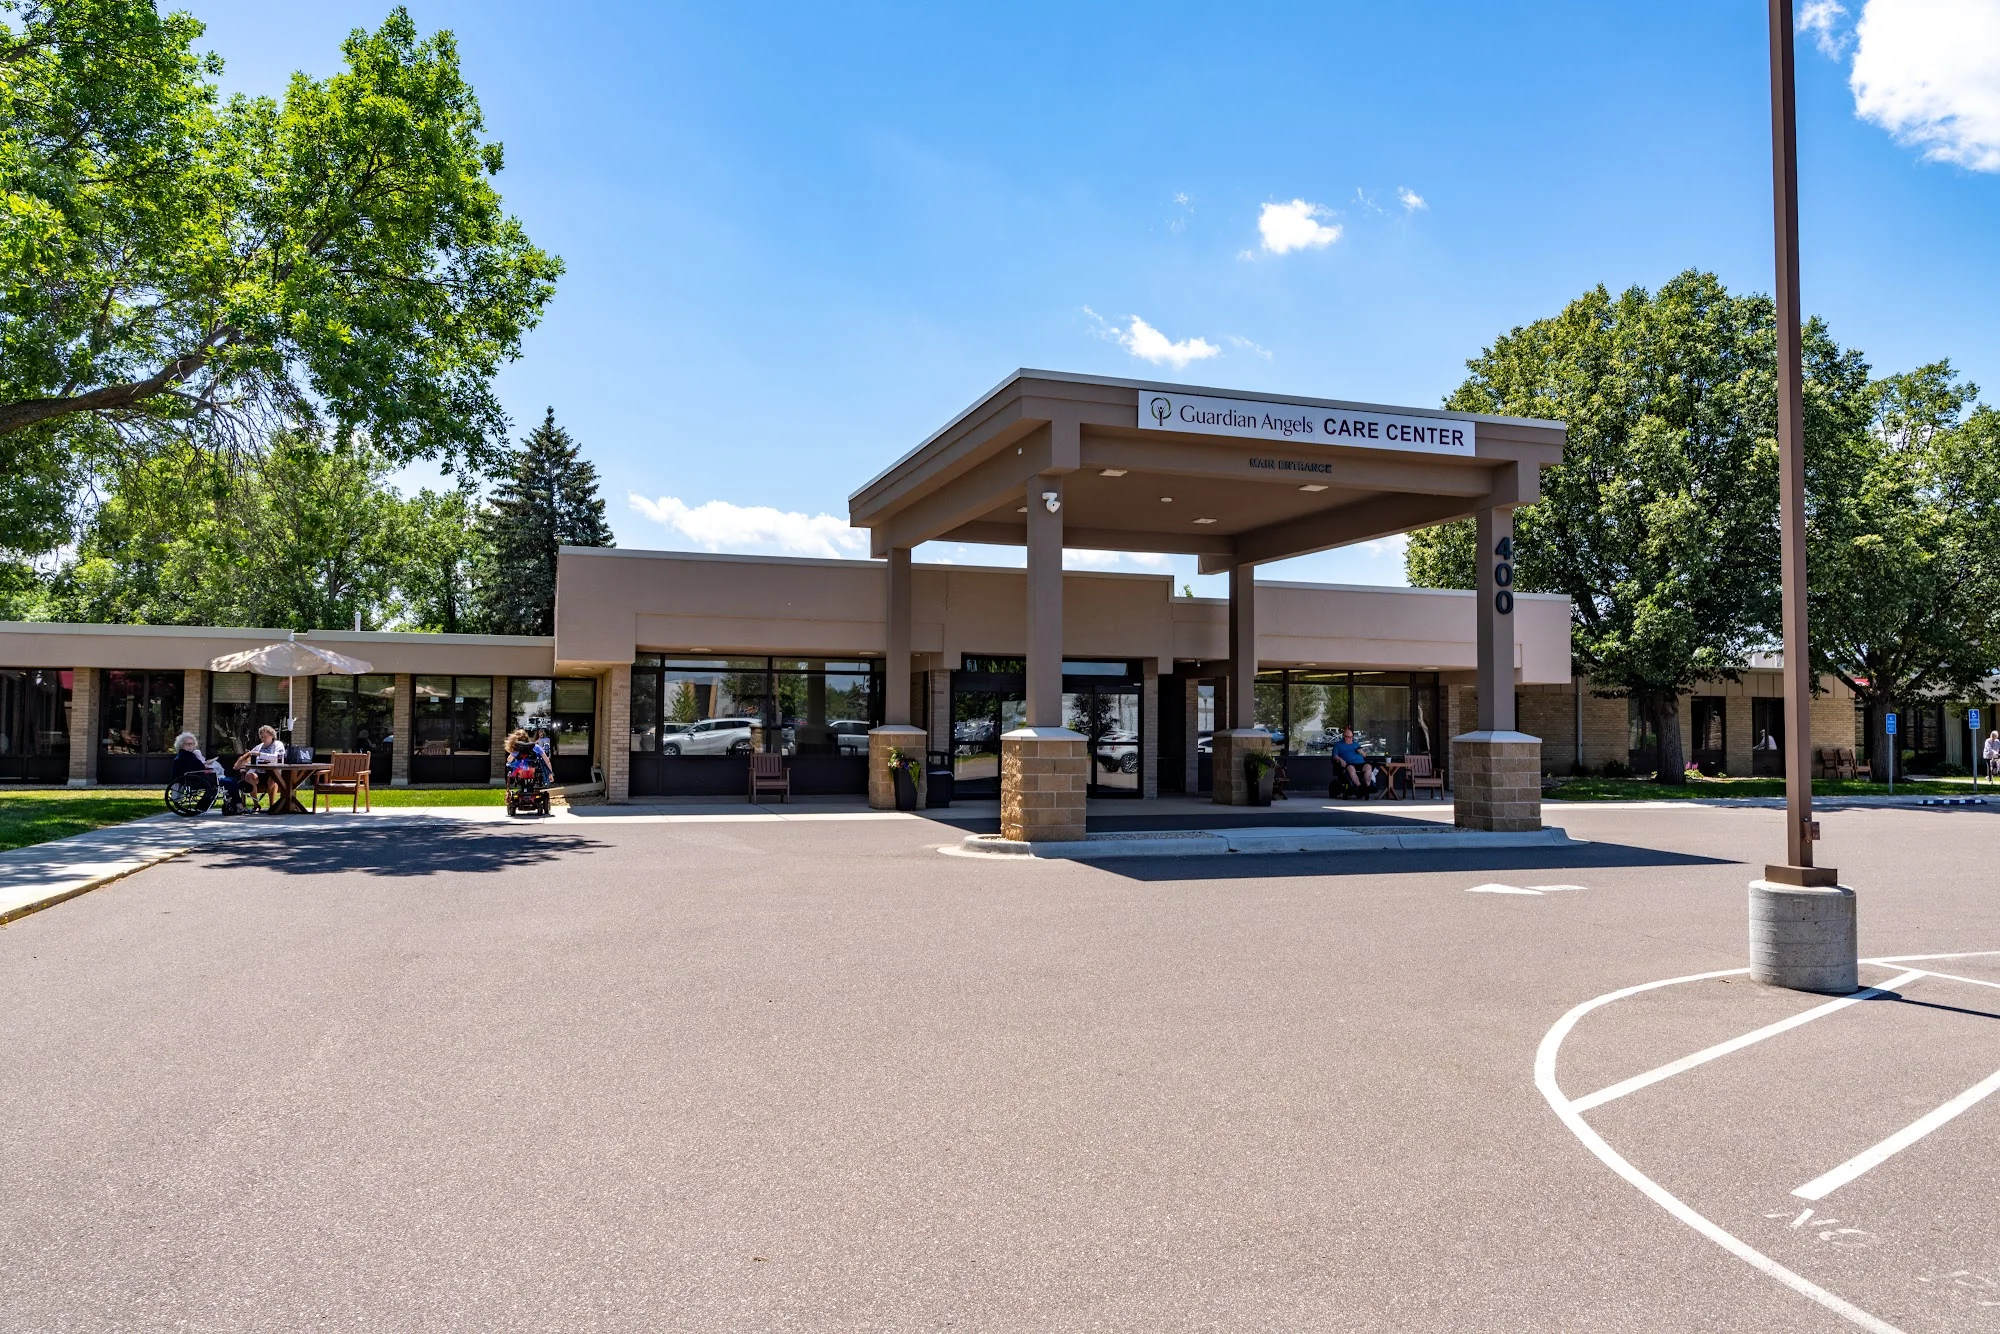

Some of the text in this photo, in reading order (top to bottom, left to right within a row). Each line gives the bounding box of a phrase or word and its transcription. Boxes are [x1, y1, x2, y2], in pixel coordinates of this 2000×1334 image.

[1180, 405, 1465, 446] Guardian Angels CARE CENTER
[1249, 457, 1332, 474] MAIN ENTRANCE
[1494, 536, 1514, 615] 400
